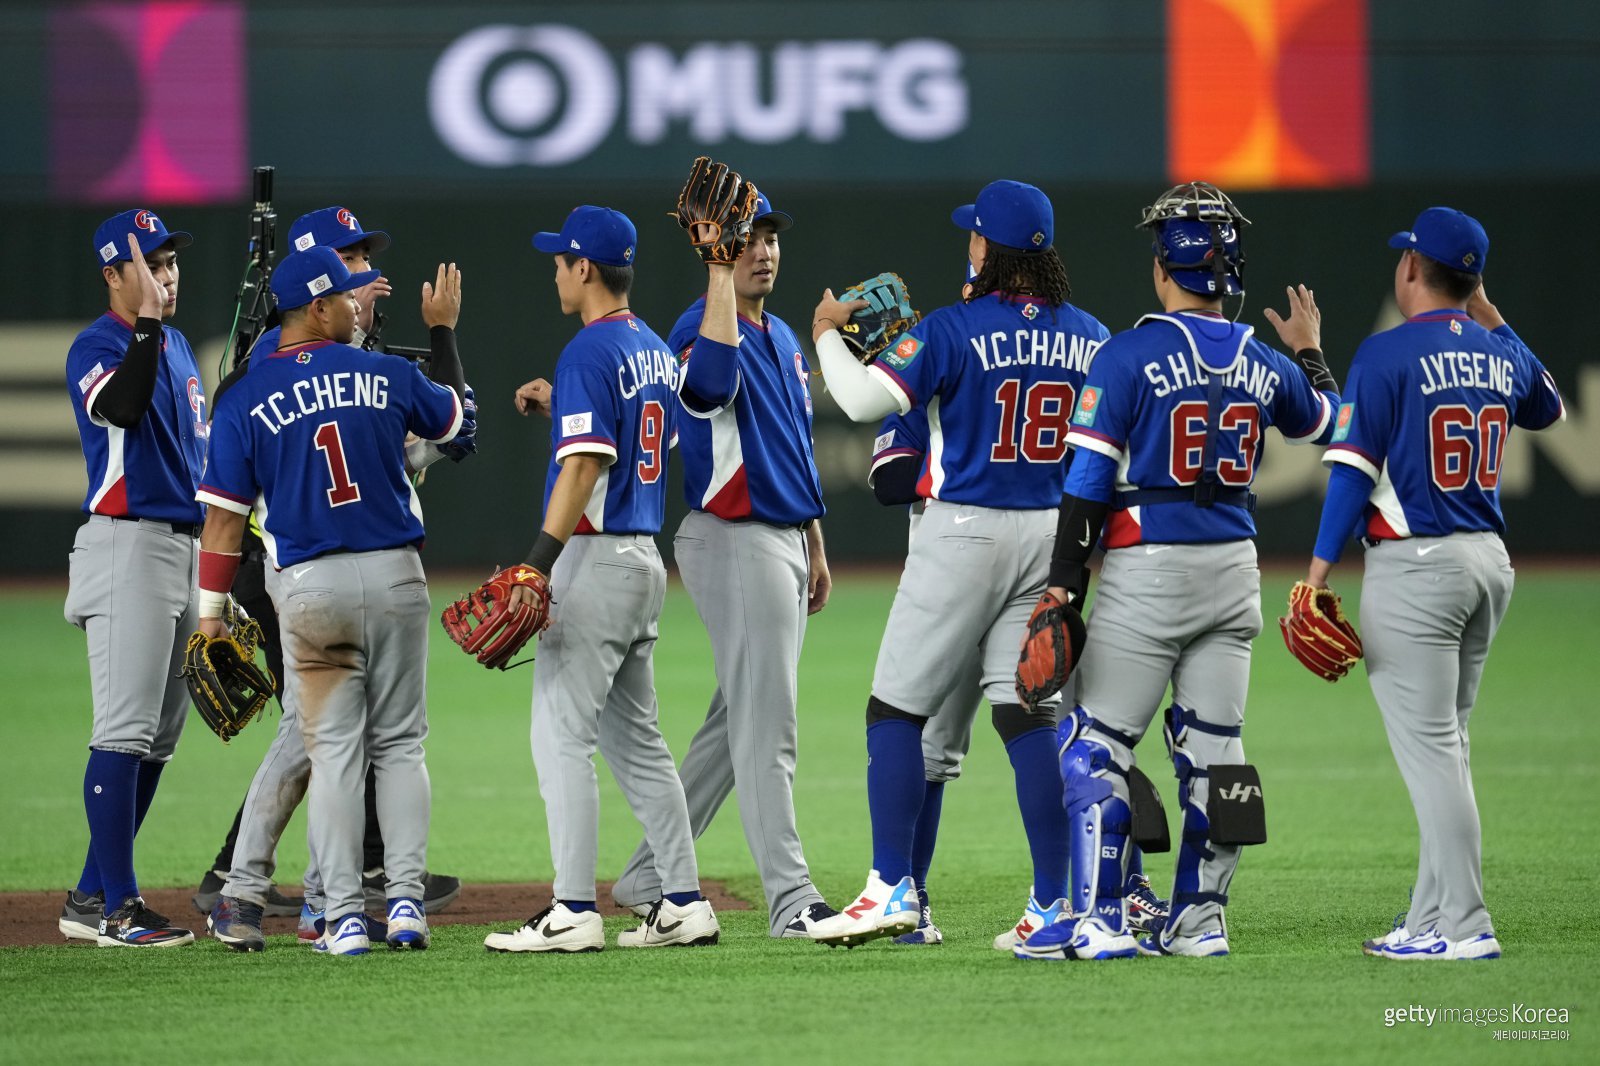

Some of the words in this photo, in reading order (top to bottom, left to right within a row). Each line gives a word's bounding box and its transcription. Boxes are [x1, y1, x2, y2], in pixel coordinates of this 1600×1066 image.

[627, 40, 968, 144] MUFG
[249, 371, 389, 435] T.C.CHENG
[1143, 351, 1280, 406] S.H.CANG
[1420, 351, 1514, 397] J.Y.TSENG
[637, 400, 665, 485] 9
[989, 378, 1076, 464] 18
[1168, 400, 1261, 487] 63
[1429, 404, 1509, 492] 60
[313, 420, 362, 508] 1
[1101, 845, 1118, 859] 63
